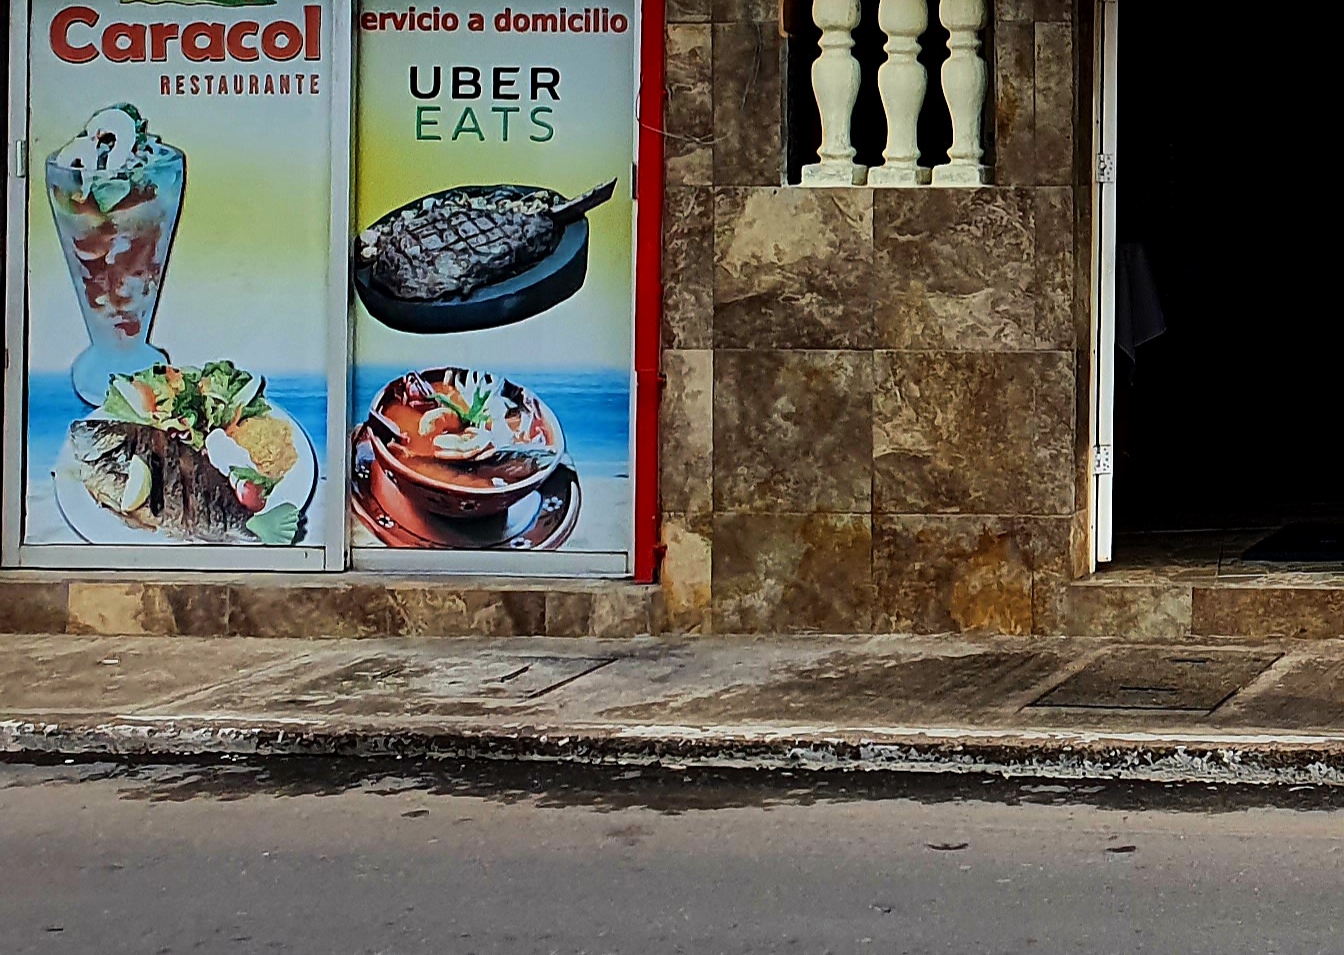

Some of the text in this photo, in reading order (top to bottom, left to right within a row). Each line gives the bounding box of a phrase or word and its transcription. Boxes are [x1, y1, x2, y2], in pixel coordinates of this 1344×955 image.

[49, 4, 322, 64] Caracol
[359, 6, 629, 34] ervicio a domicilio
[159, 73, 321, 96] RESTAURANTE
[408, 65, 562, 101] UBER
[415, 105, 555, 142] EATS
